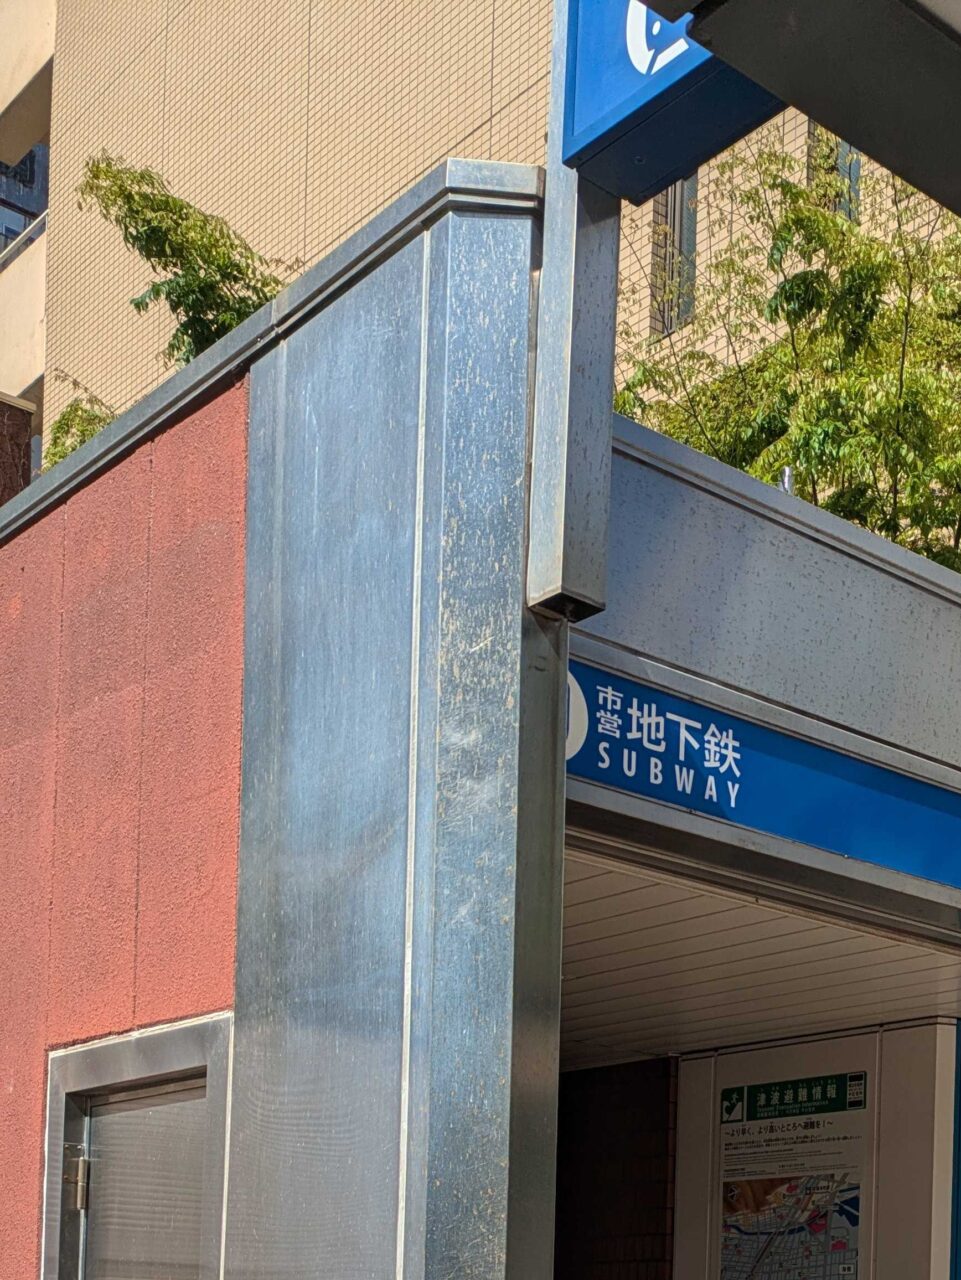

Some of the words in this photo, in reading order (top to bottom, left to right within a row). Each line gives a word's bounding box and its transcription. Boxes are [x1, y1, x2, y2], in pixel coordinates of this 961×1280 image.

[626, 698, 741, 778] 地下鉄
[597, 742, 740, 808] SUBWAY
